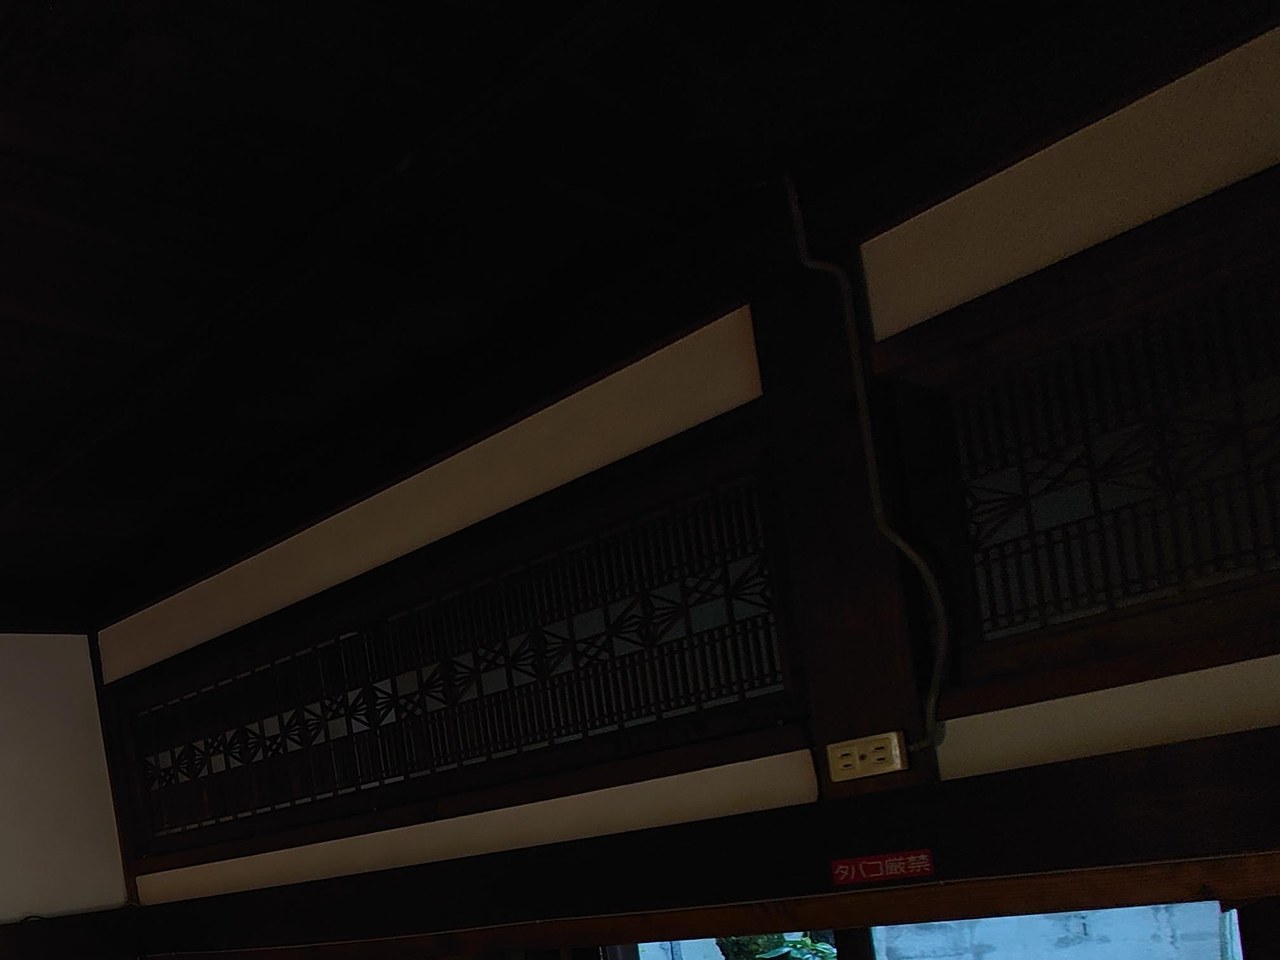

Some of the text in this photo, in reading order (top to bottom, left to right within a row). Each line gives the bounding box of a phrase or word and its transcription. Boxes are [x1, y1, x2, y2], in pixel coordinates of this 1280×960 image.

[835, 854, 931, 880] タバコ厳禁
